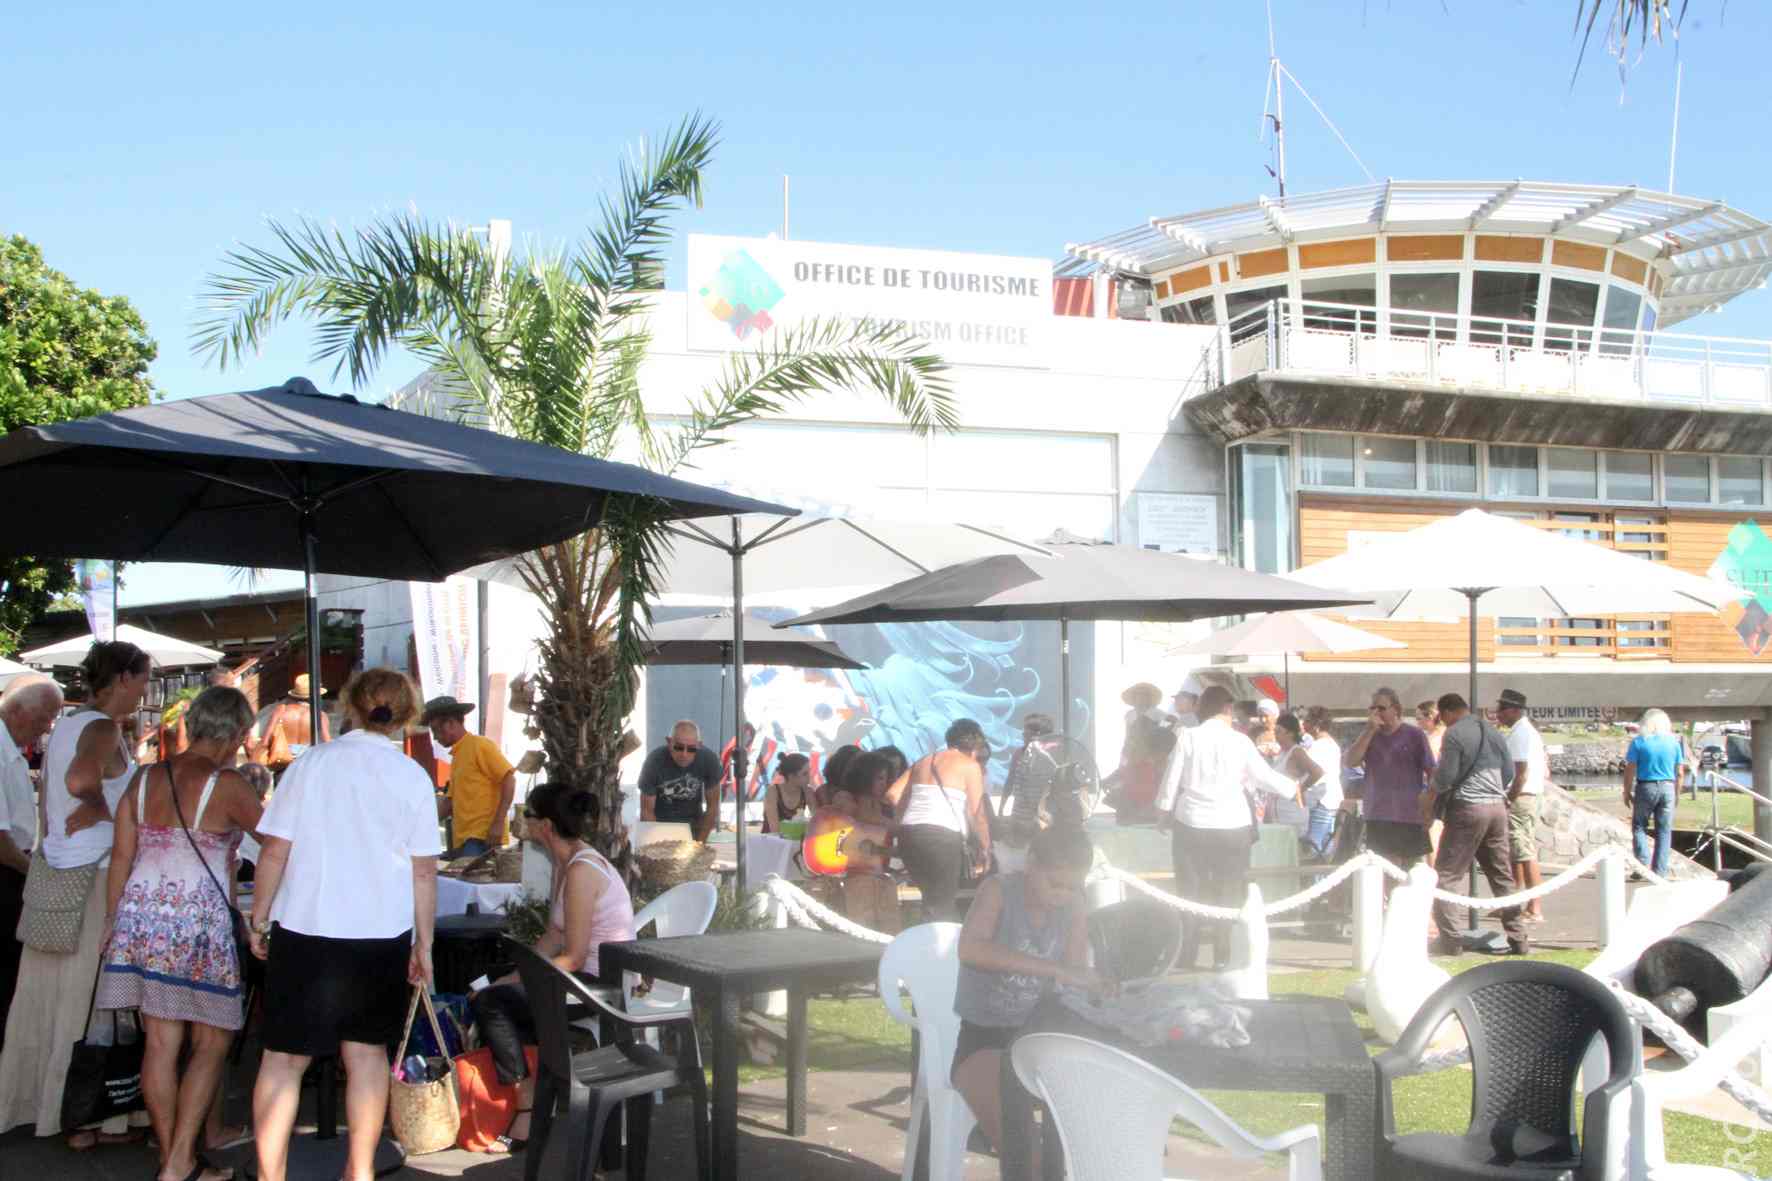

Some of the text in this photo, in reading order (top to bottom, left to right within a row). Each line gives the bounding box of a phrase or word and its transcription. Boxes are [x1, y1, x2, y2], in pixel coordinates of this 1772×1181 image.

[794, 261, 1040, 297] OFFICE DE TOURISME
[851, 317, 1029, 345] TOURISM OFFICE
